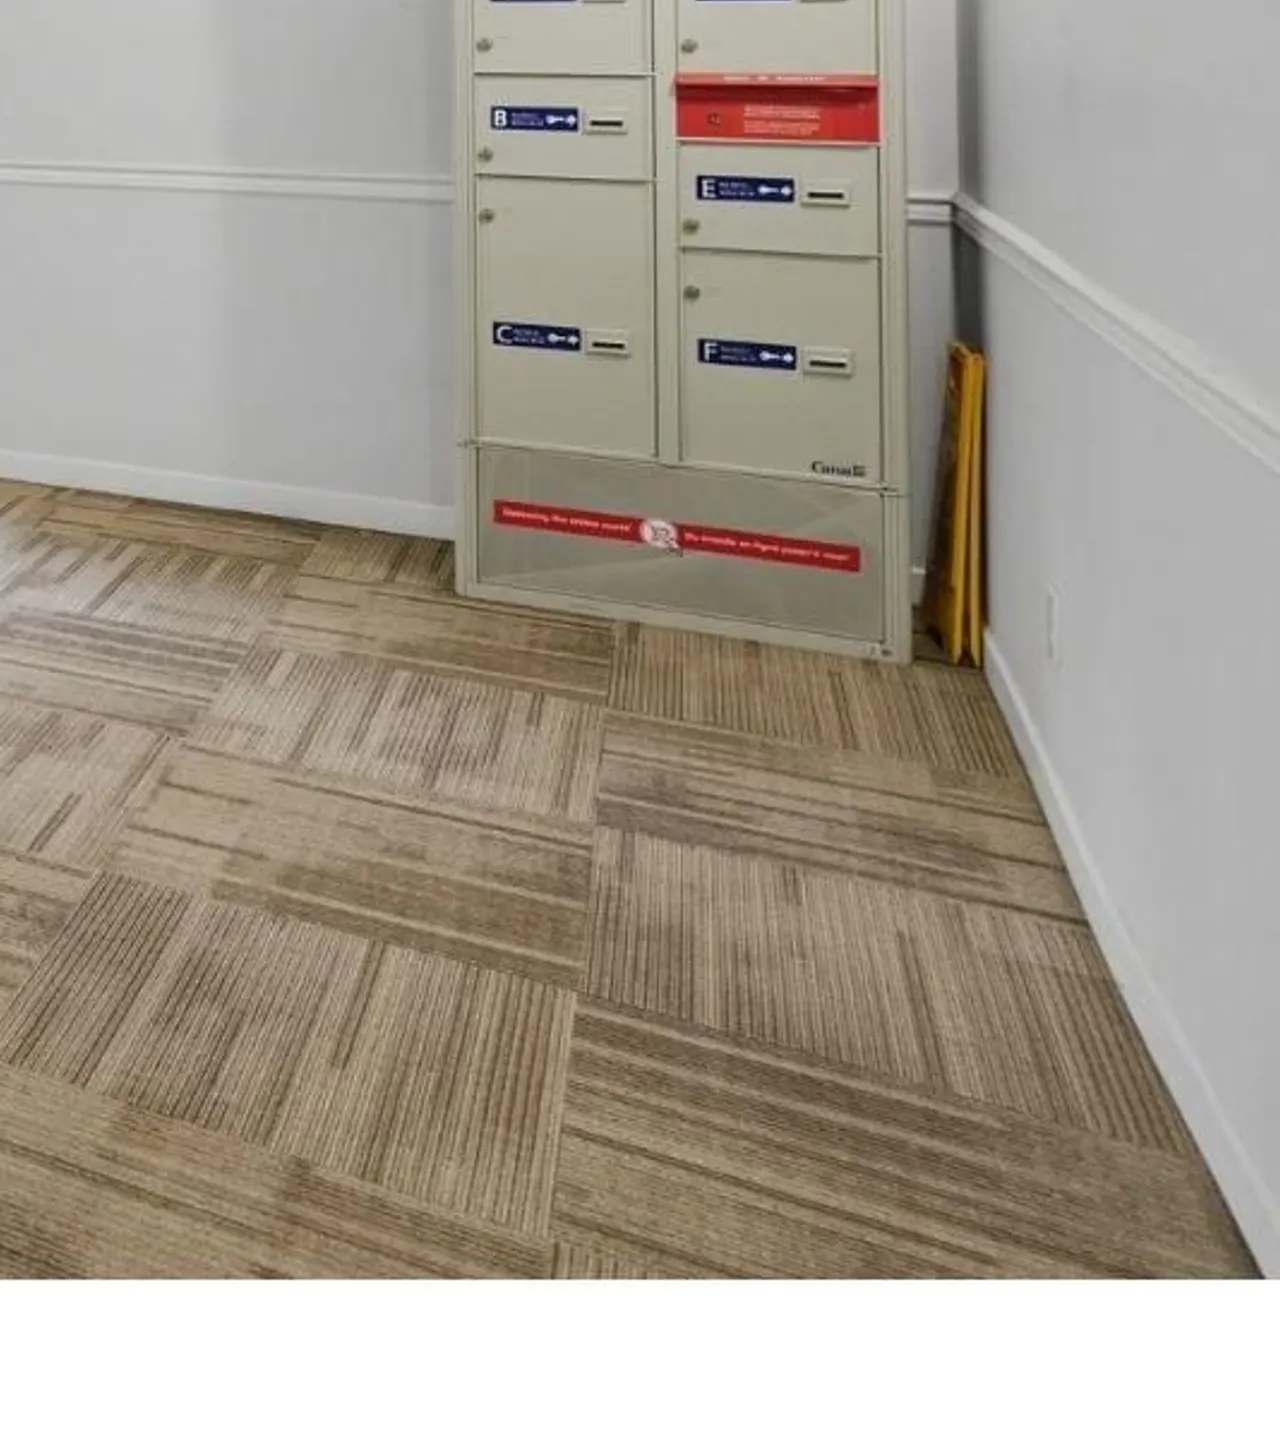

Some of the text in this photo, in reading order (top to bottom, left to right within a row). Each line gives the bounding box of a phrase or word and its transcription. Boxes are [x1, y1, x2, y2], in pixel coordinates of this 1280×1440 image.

[494, 110, 508, 127] B
[701, 178, 717, 199] E
[496, 324, 512, 345] C
[704, 342, 718, 361] F
